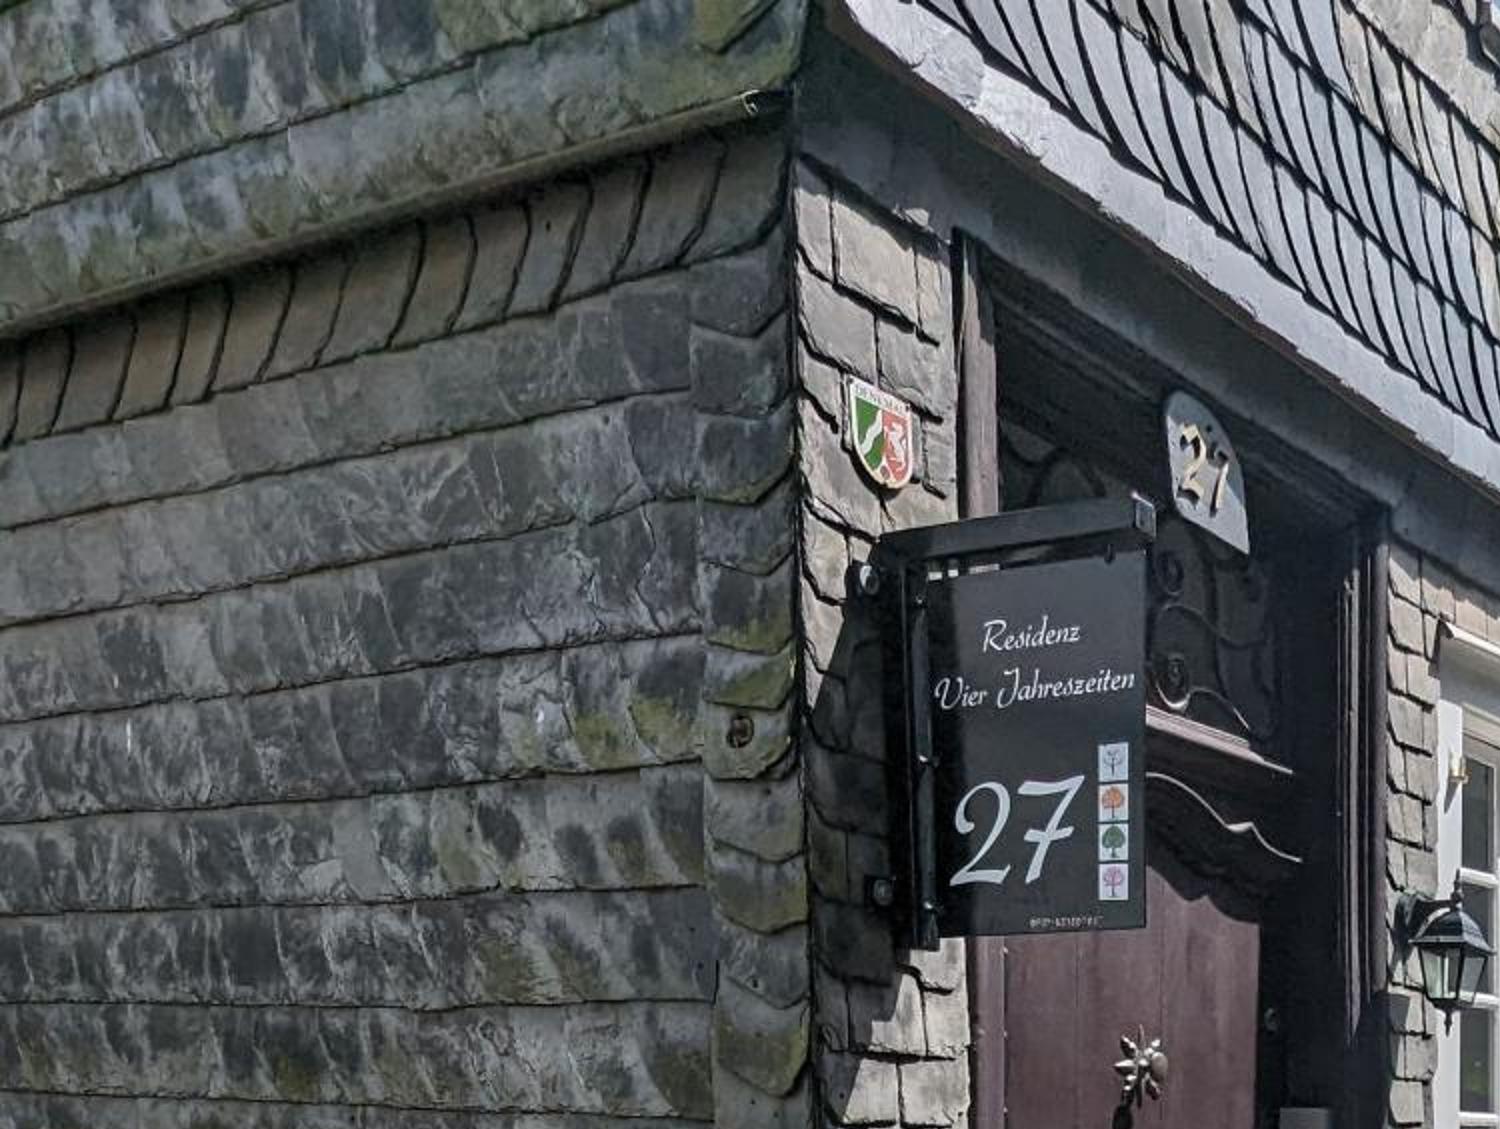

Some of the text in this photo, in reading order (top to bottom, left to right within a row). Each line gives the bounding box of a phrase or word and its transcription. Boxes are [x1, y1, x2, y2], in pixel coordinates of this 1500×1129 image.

[1176, 425, 1230, 518] 27
[982, 614, 1081, 653] Residenz
[934, 667, 1136, 710] Vier Jahreszeiten
[949, 775, 1086, 887] 27
